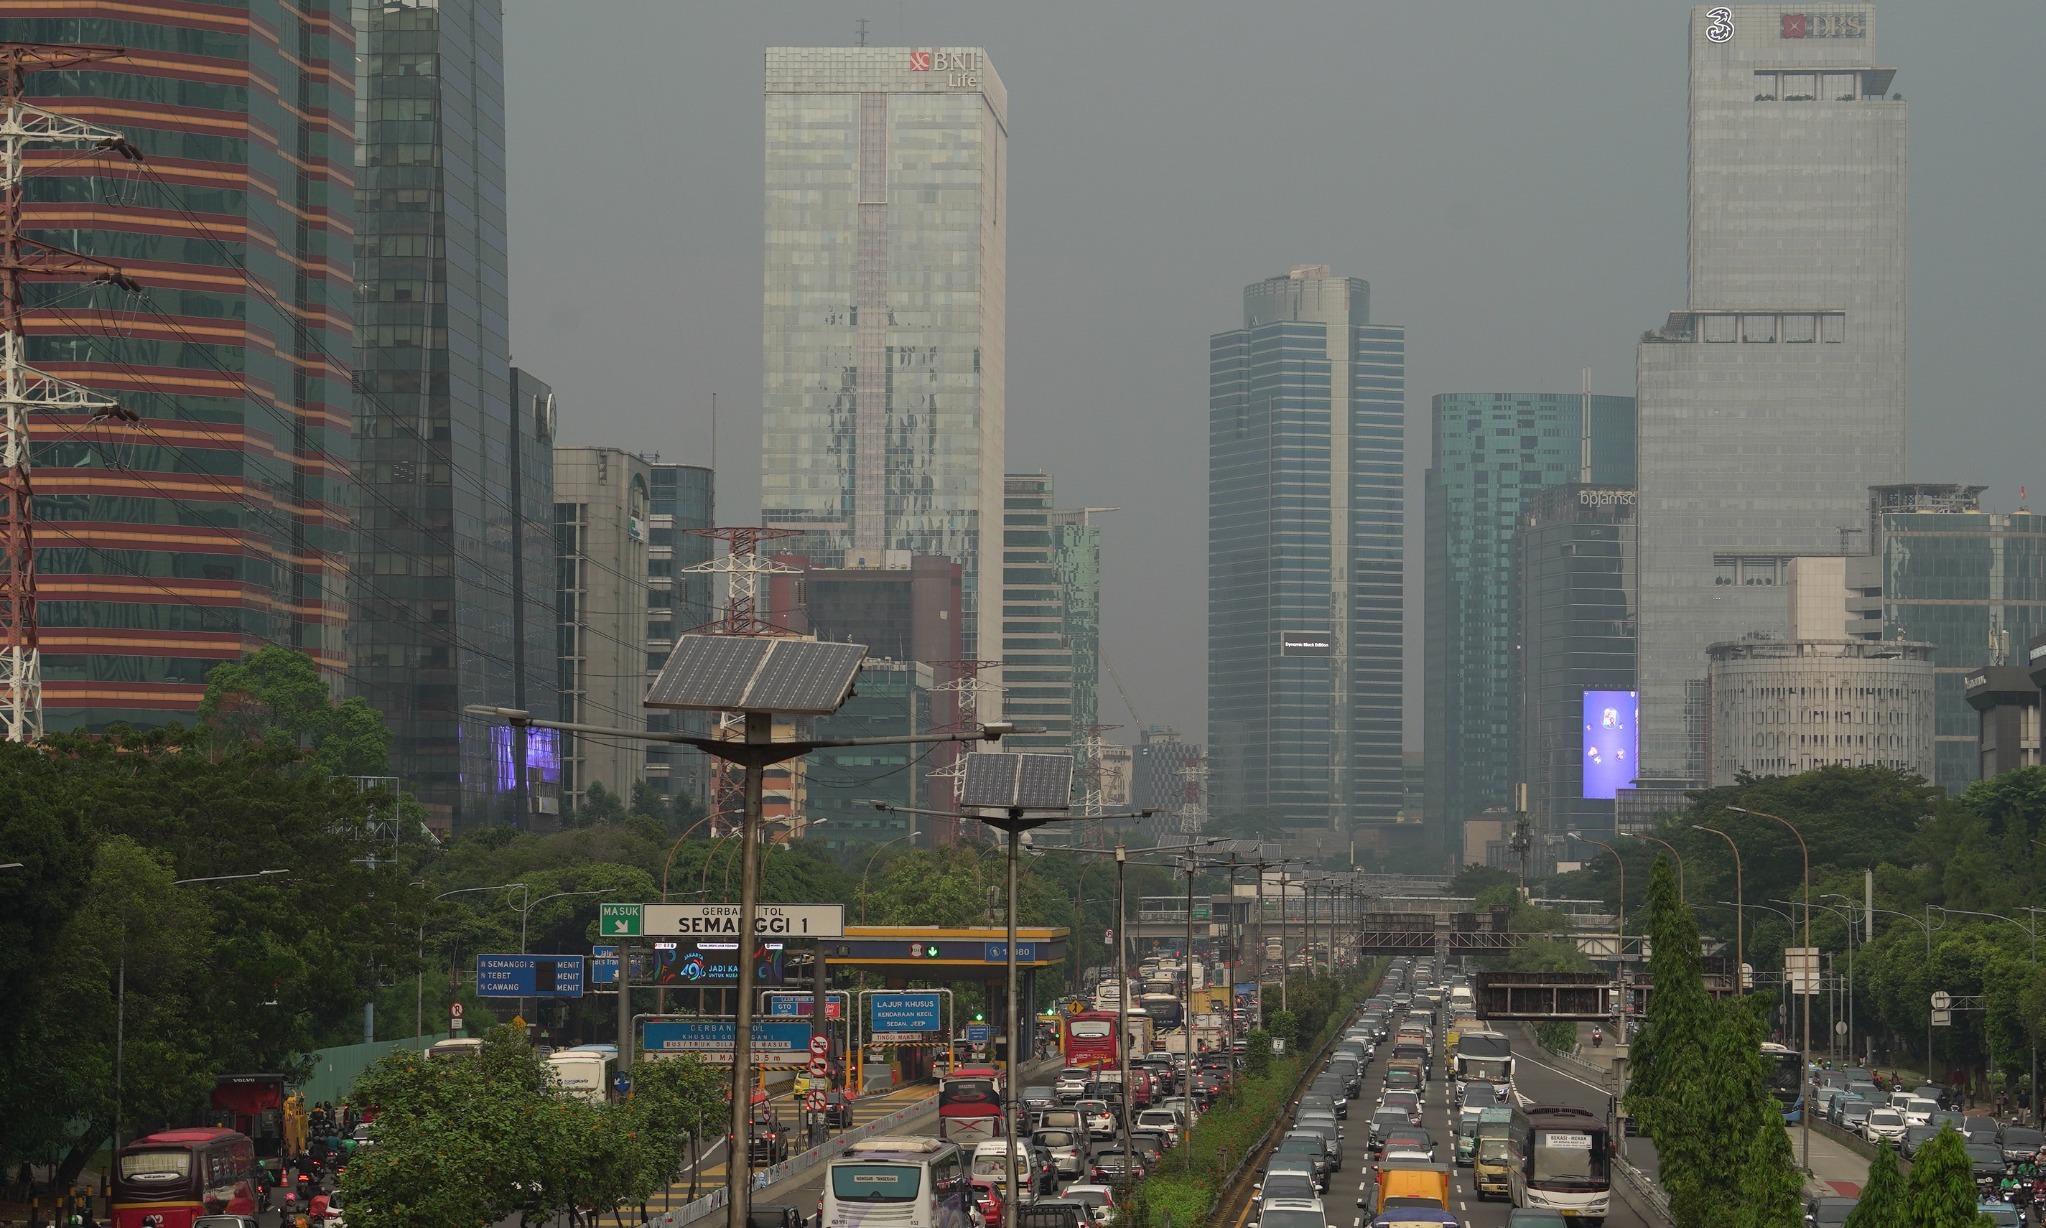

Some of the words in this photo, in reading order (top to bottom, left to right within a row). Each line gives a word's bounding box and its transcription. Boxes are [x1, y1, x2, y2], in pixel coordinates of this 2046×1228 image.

[1812, 15, 1861, 37] DBS
[933, 51, 977, 72] BNI
[948, 73, 977, 87] Life
[603, 907, 639, 916] MASUK
[763, 907, 784, 916] TOL
[678, 917, 790, 933] SEMAGGI
[801, 917, 808, 933] 1
[683, 952, 704, 960] JAKARTA
[487, 960, 528, 968] SEMANGGI
[529, 960, 535, 968] 2
[557, 961, 580, 969] MENIT
[557, 972, 580, 980] MENIT
[487, 983, 519, 991] CAWANG
[556, 983, 580, 991] MENIT
[755, 1054, 770, 1062] 3.5
